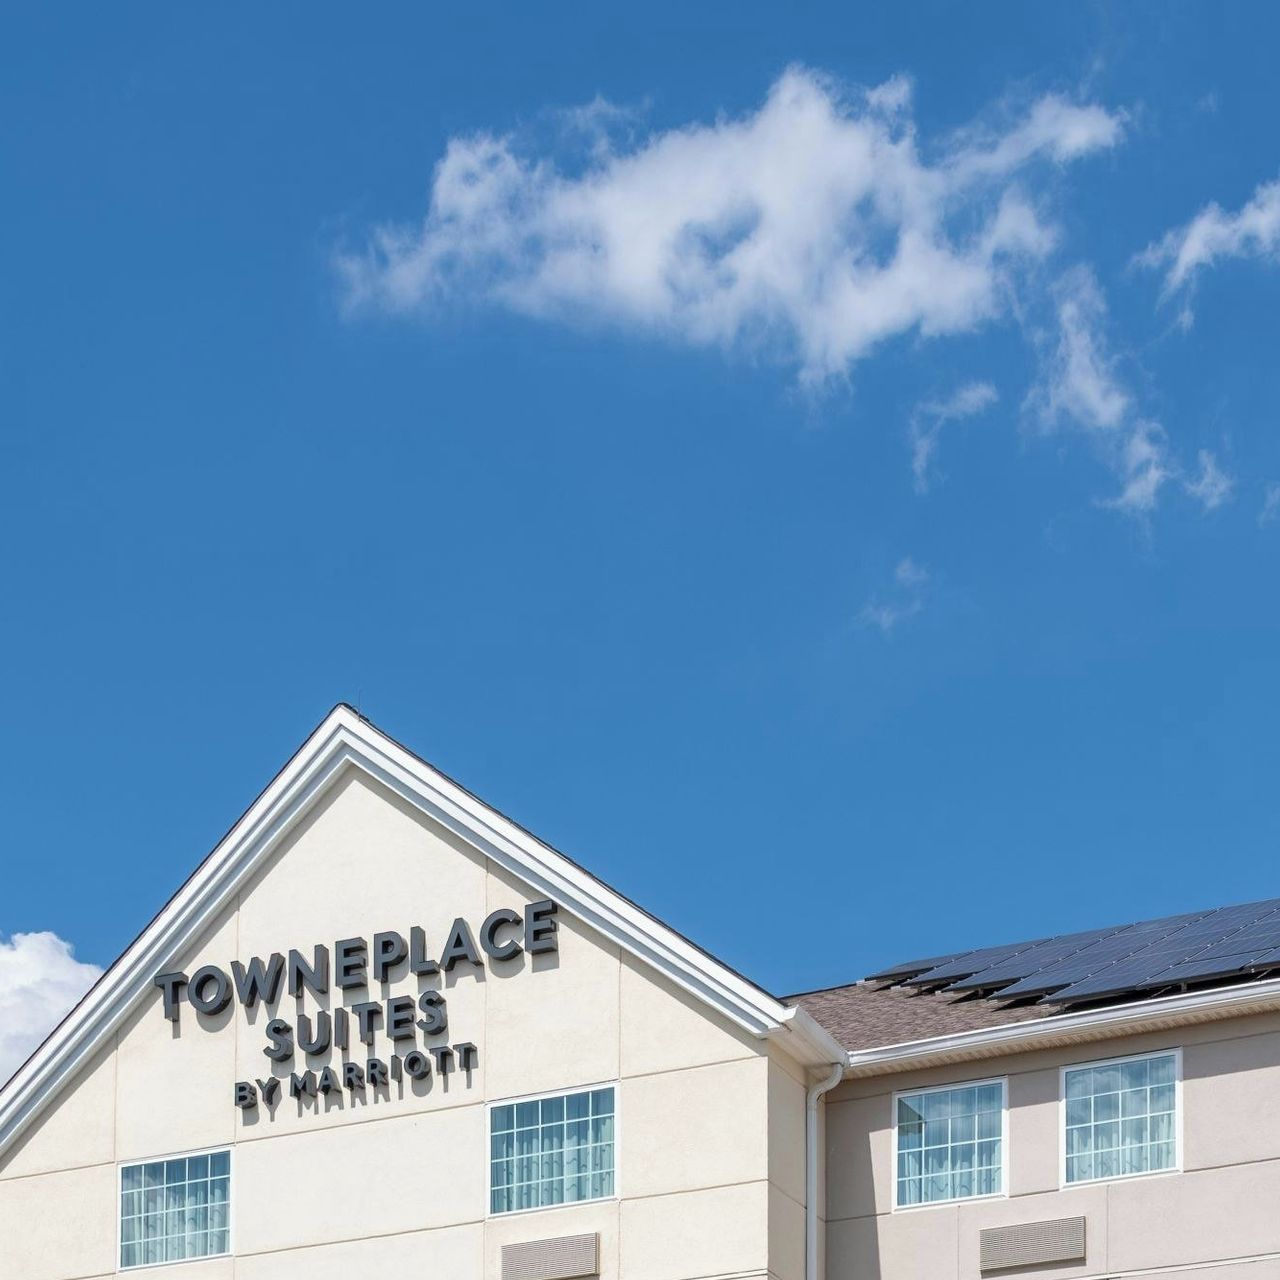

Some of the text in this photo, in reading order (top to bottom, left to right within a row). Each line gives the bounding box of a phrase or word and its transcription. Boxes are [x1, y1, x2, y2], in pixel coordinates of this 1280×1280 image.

[154, 900, 558, 1022] TOWNEPLACE
[263, 990, 448, 1062] SUITES
[234, 1042, 478, 1109] BY MARRIOTT
